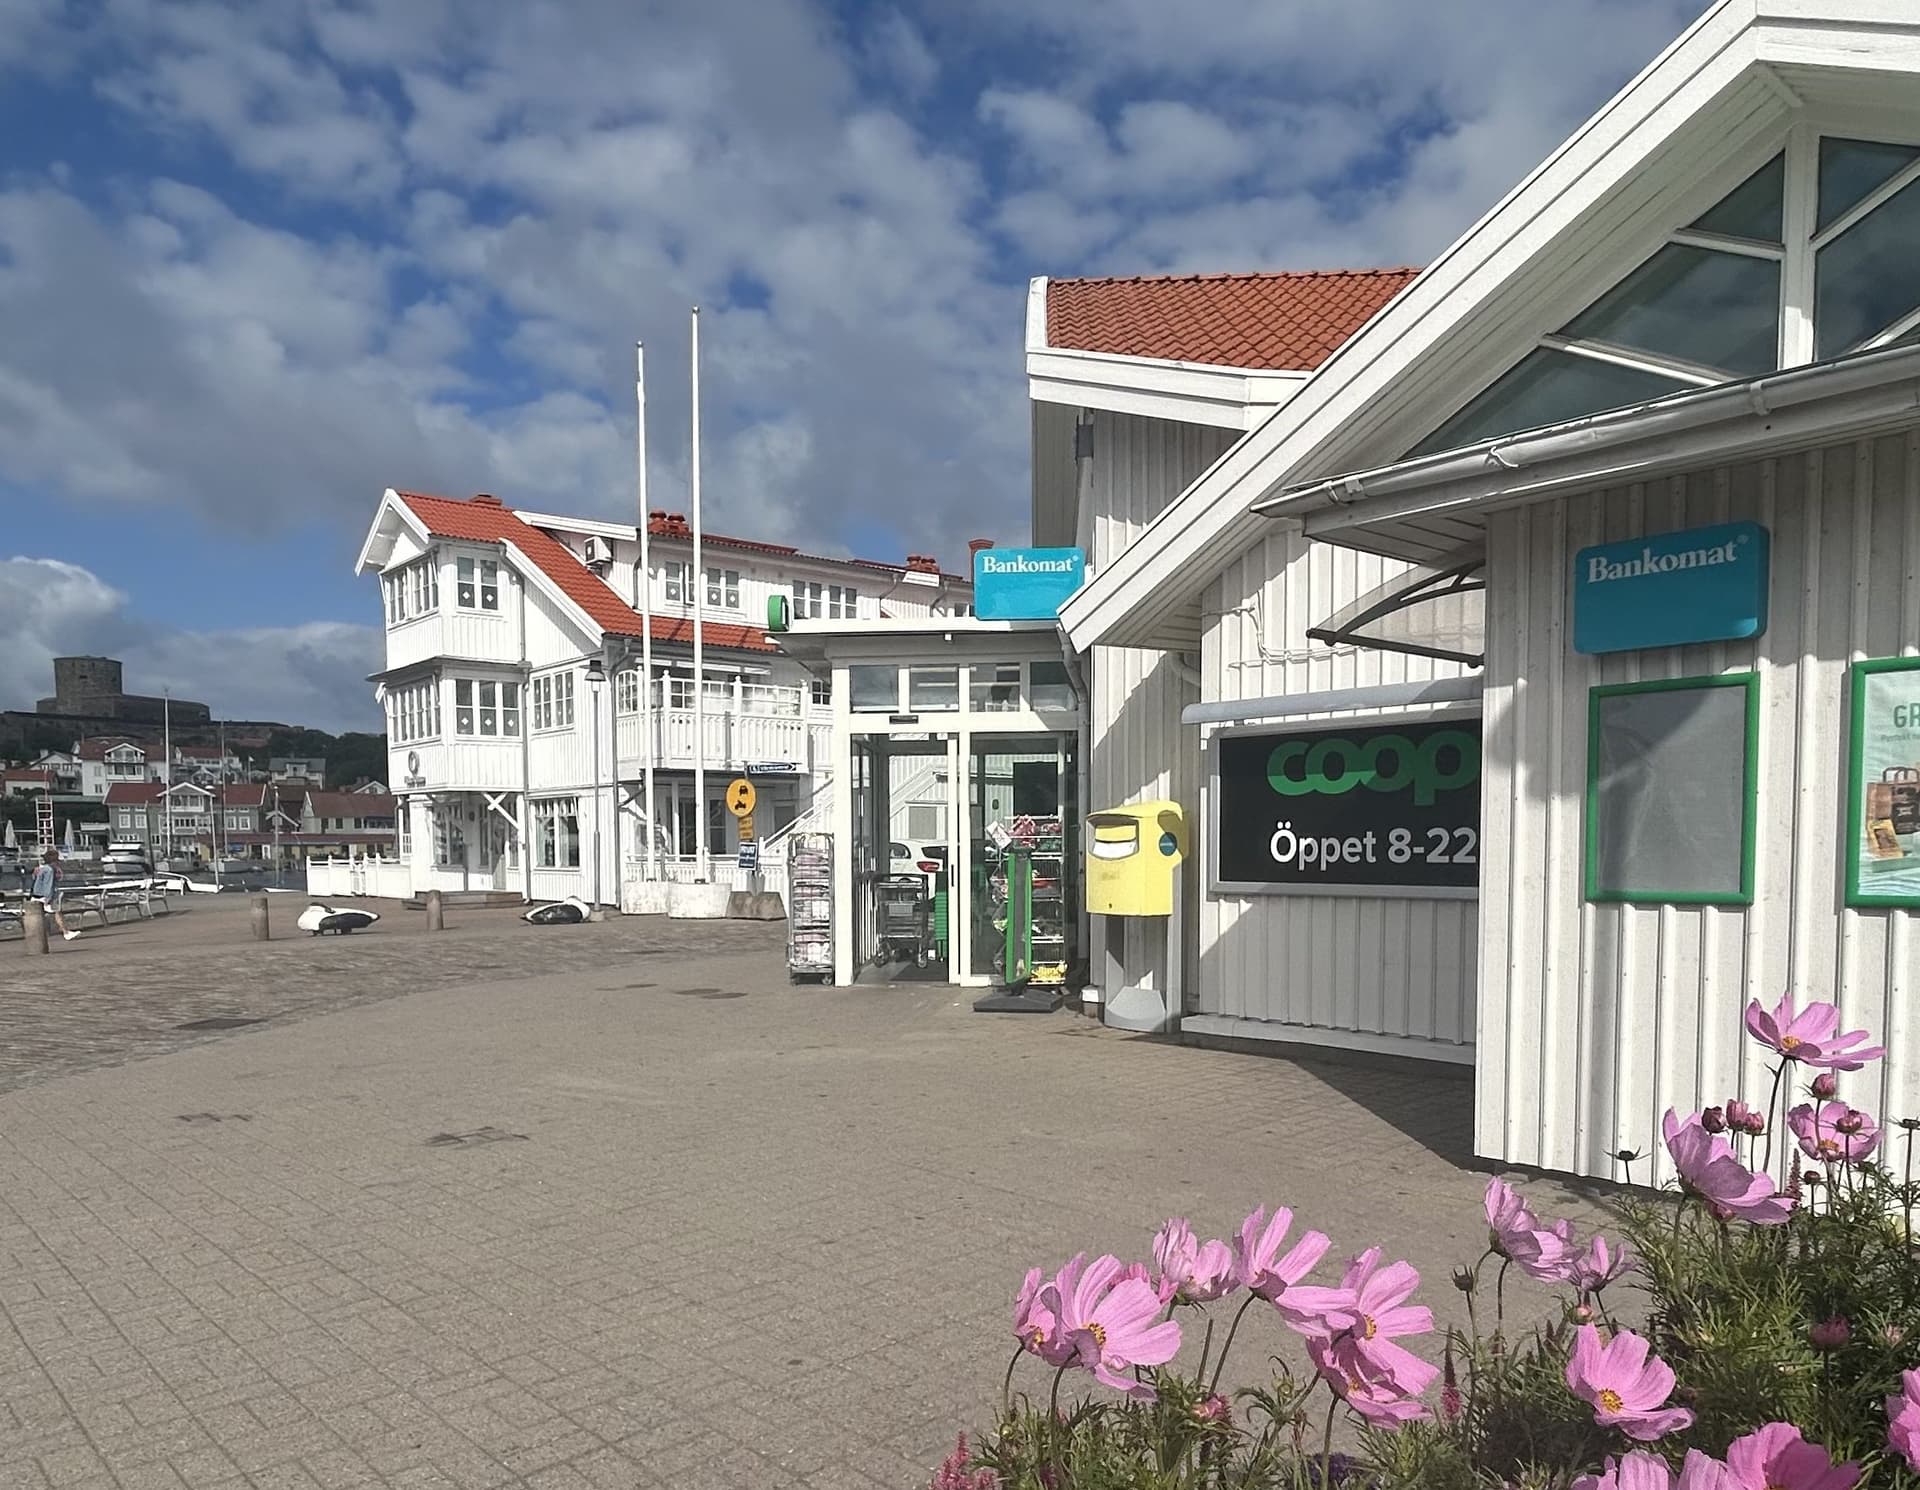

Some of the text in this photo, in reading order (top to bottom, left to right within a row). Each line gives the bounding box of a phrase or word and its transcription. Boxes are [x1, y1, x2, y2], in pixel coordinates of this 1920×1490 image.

[982, 555, 1073, 573] Bankomat
[1587, 541, 1737, 583] Bankomat
[1267, 730, 1481, 806] coop
[1270, 821, 1477, 872] Öppet 8-22
